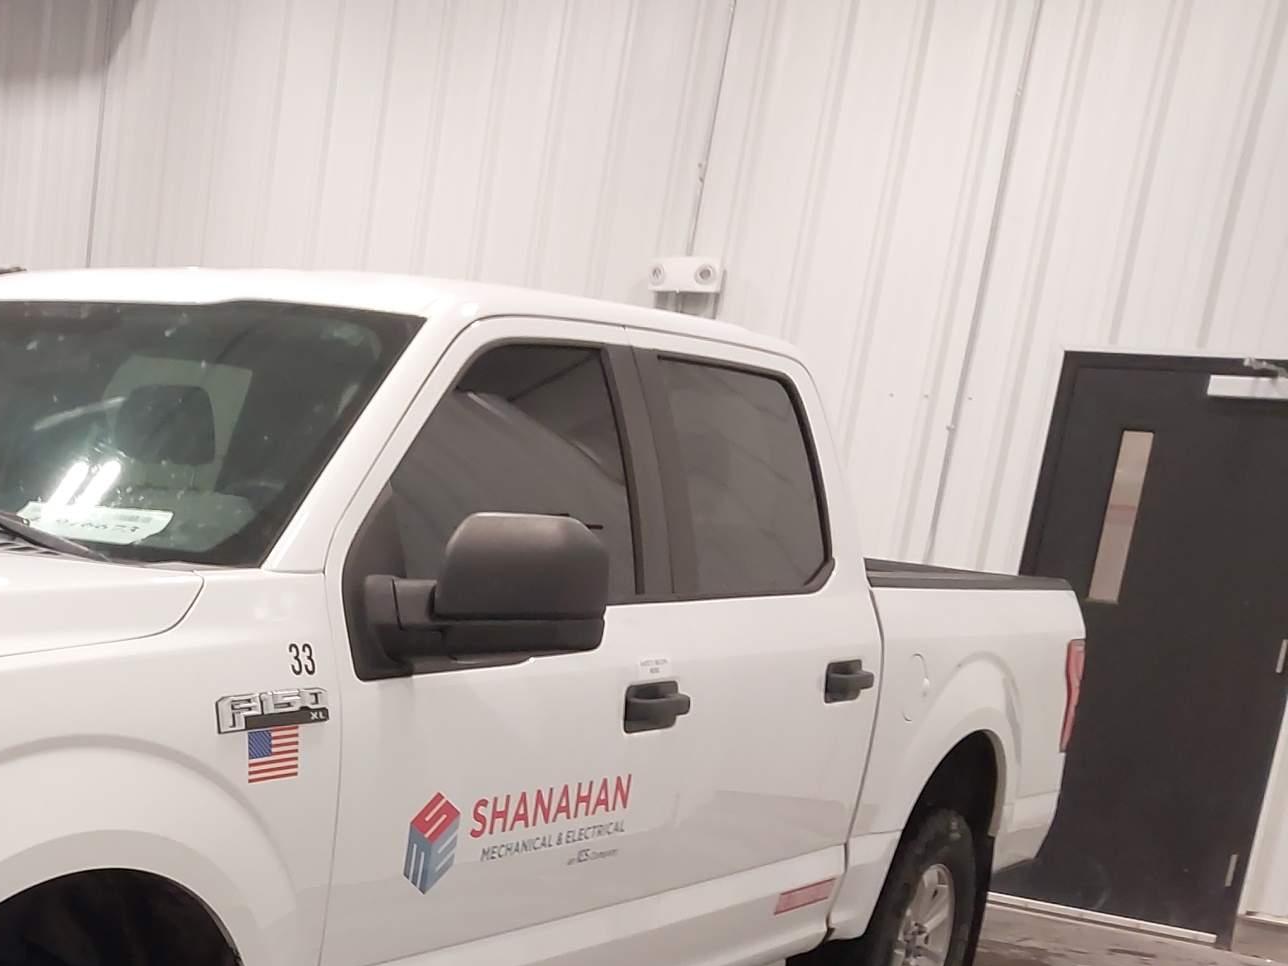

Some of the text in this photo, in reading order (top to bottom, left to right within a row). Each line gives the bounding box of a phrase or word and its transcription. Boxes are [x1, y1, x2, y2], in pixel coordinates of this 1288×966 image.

[289, 643, 316, 675] 33
[310, 711, 326, 721] XL
[470, 774, 632, 838] SHANAHAN
[480, 820, 625, 861] MECHANICAL & ELECTRICAL
